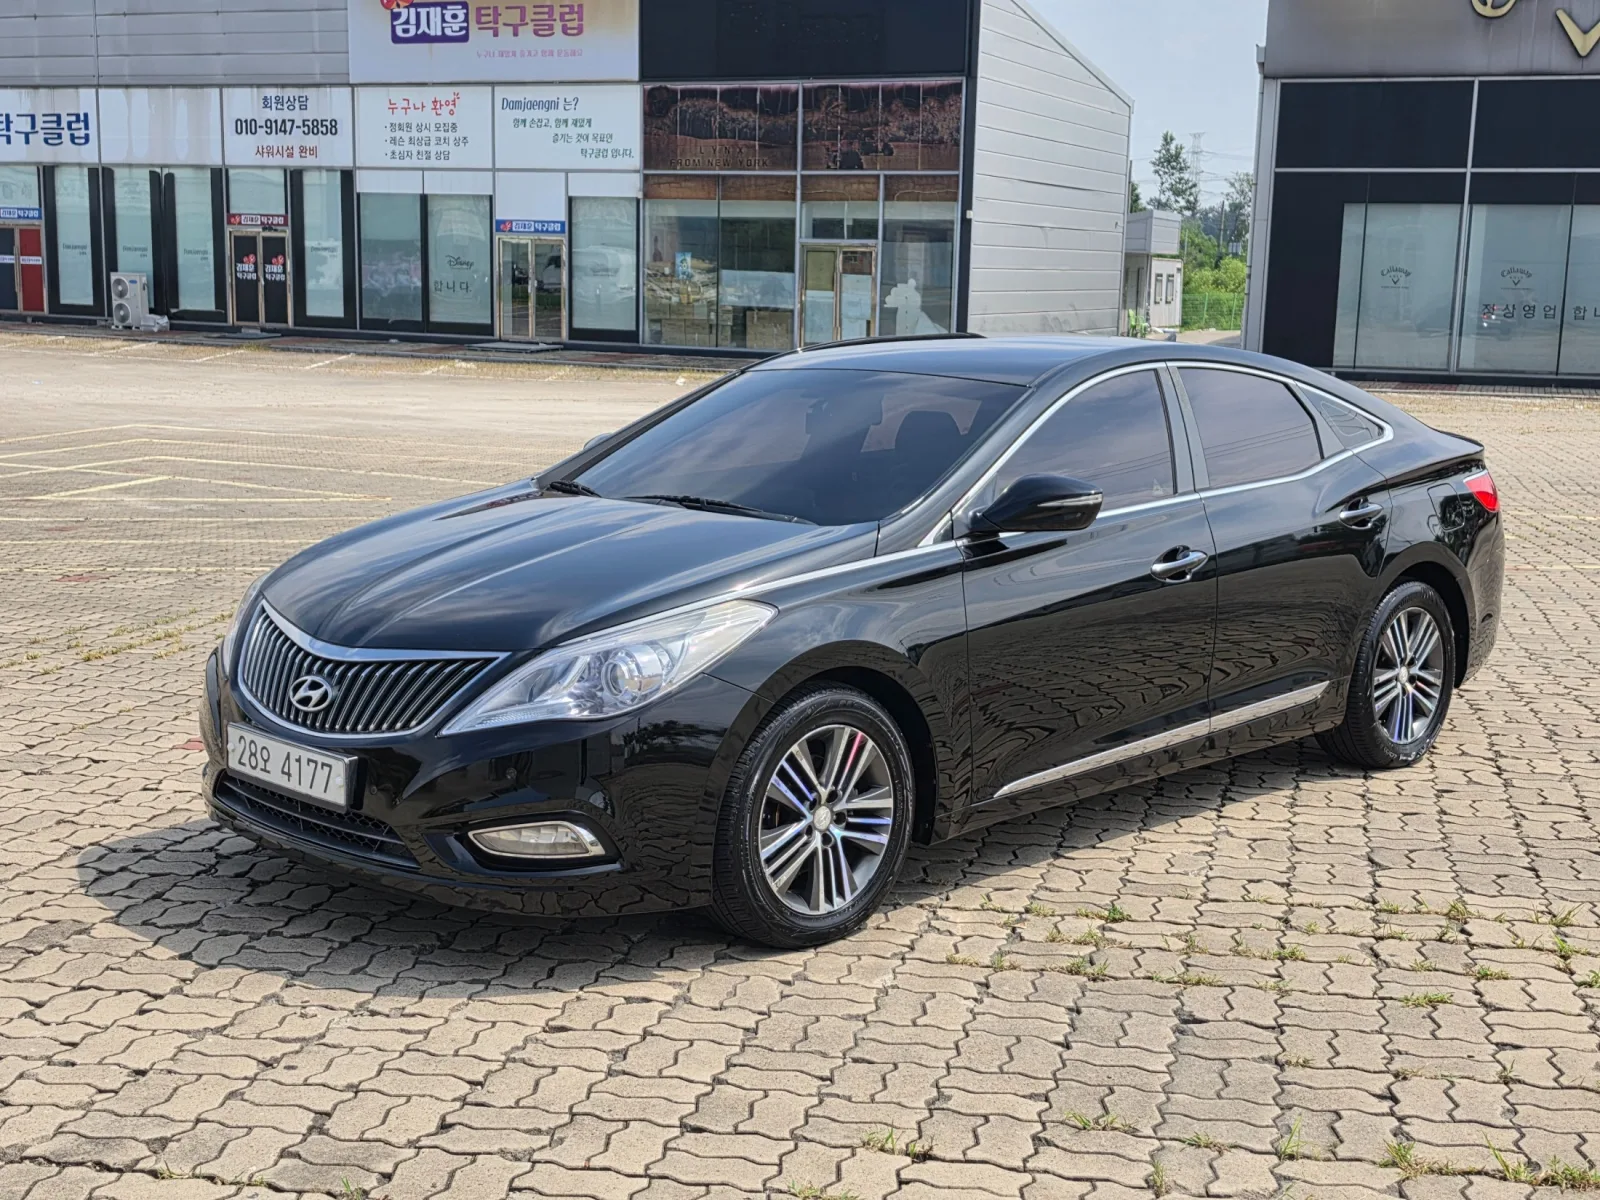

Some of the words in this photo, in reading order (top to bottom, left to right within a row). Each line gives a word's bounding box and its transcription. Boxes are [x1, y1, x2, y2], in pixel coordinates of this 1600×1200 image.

[392, 5, 468, 38] 김재훈
[475, 3, 585, 38] 탁구클럽
[261, 94, 309, 111] 회원상담
[388, 98, 426, 116] 누구나
[431, 96, 458, 116] 환영
[501, 97, 560, 112] Damjaengni
[563, 97, 580, 111] 는?
[234, 118, 338, 136] 010-9147-5858
[389, 122, 413, 133] 정회원
[415, 122, 431, 133] 상시
[434, 122, 458, 133] 모집중
[513, 118, 527, 129] 함께
[529, 118, 552, 129] 손잡고,
[554, 118, 568, 129] 함께
[389, 136, 405, 147] 레슨
[408, 136, 431, 147] 최상급
[434, 136, 450, 147] 코치
[453, 136, 469, 147] 상주
[552, 133, 573, 144] 즐기는
[575, 133, 590, 144] 것이
[592, 133, 613, 144] 목표인
[255, 145, 294, 159] 샤워시설
[298, 145, 318, 159] 완비
[390, 150, 413, 161] 초심자
[416, 150, 432, 161] 친절
[434, 150, 451, 161] 상담
[580, 148, 609, 159] 탁구클럽
[611, 148, 634, 159] 입니다.
[669, 159, 701, 167] FROM
[707, 159, 730, 167] NEW
[738, 159, 769, 167] YORK
[445, 254, 474, 270] Disney
[237, 735, 271, 774] 28오
[280, 751, 333, 794] 4177
